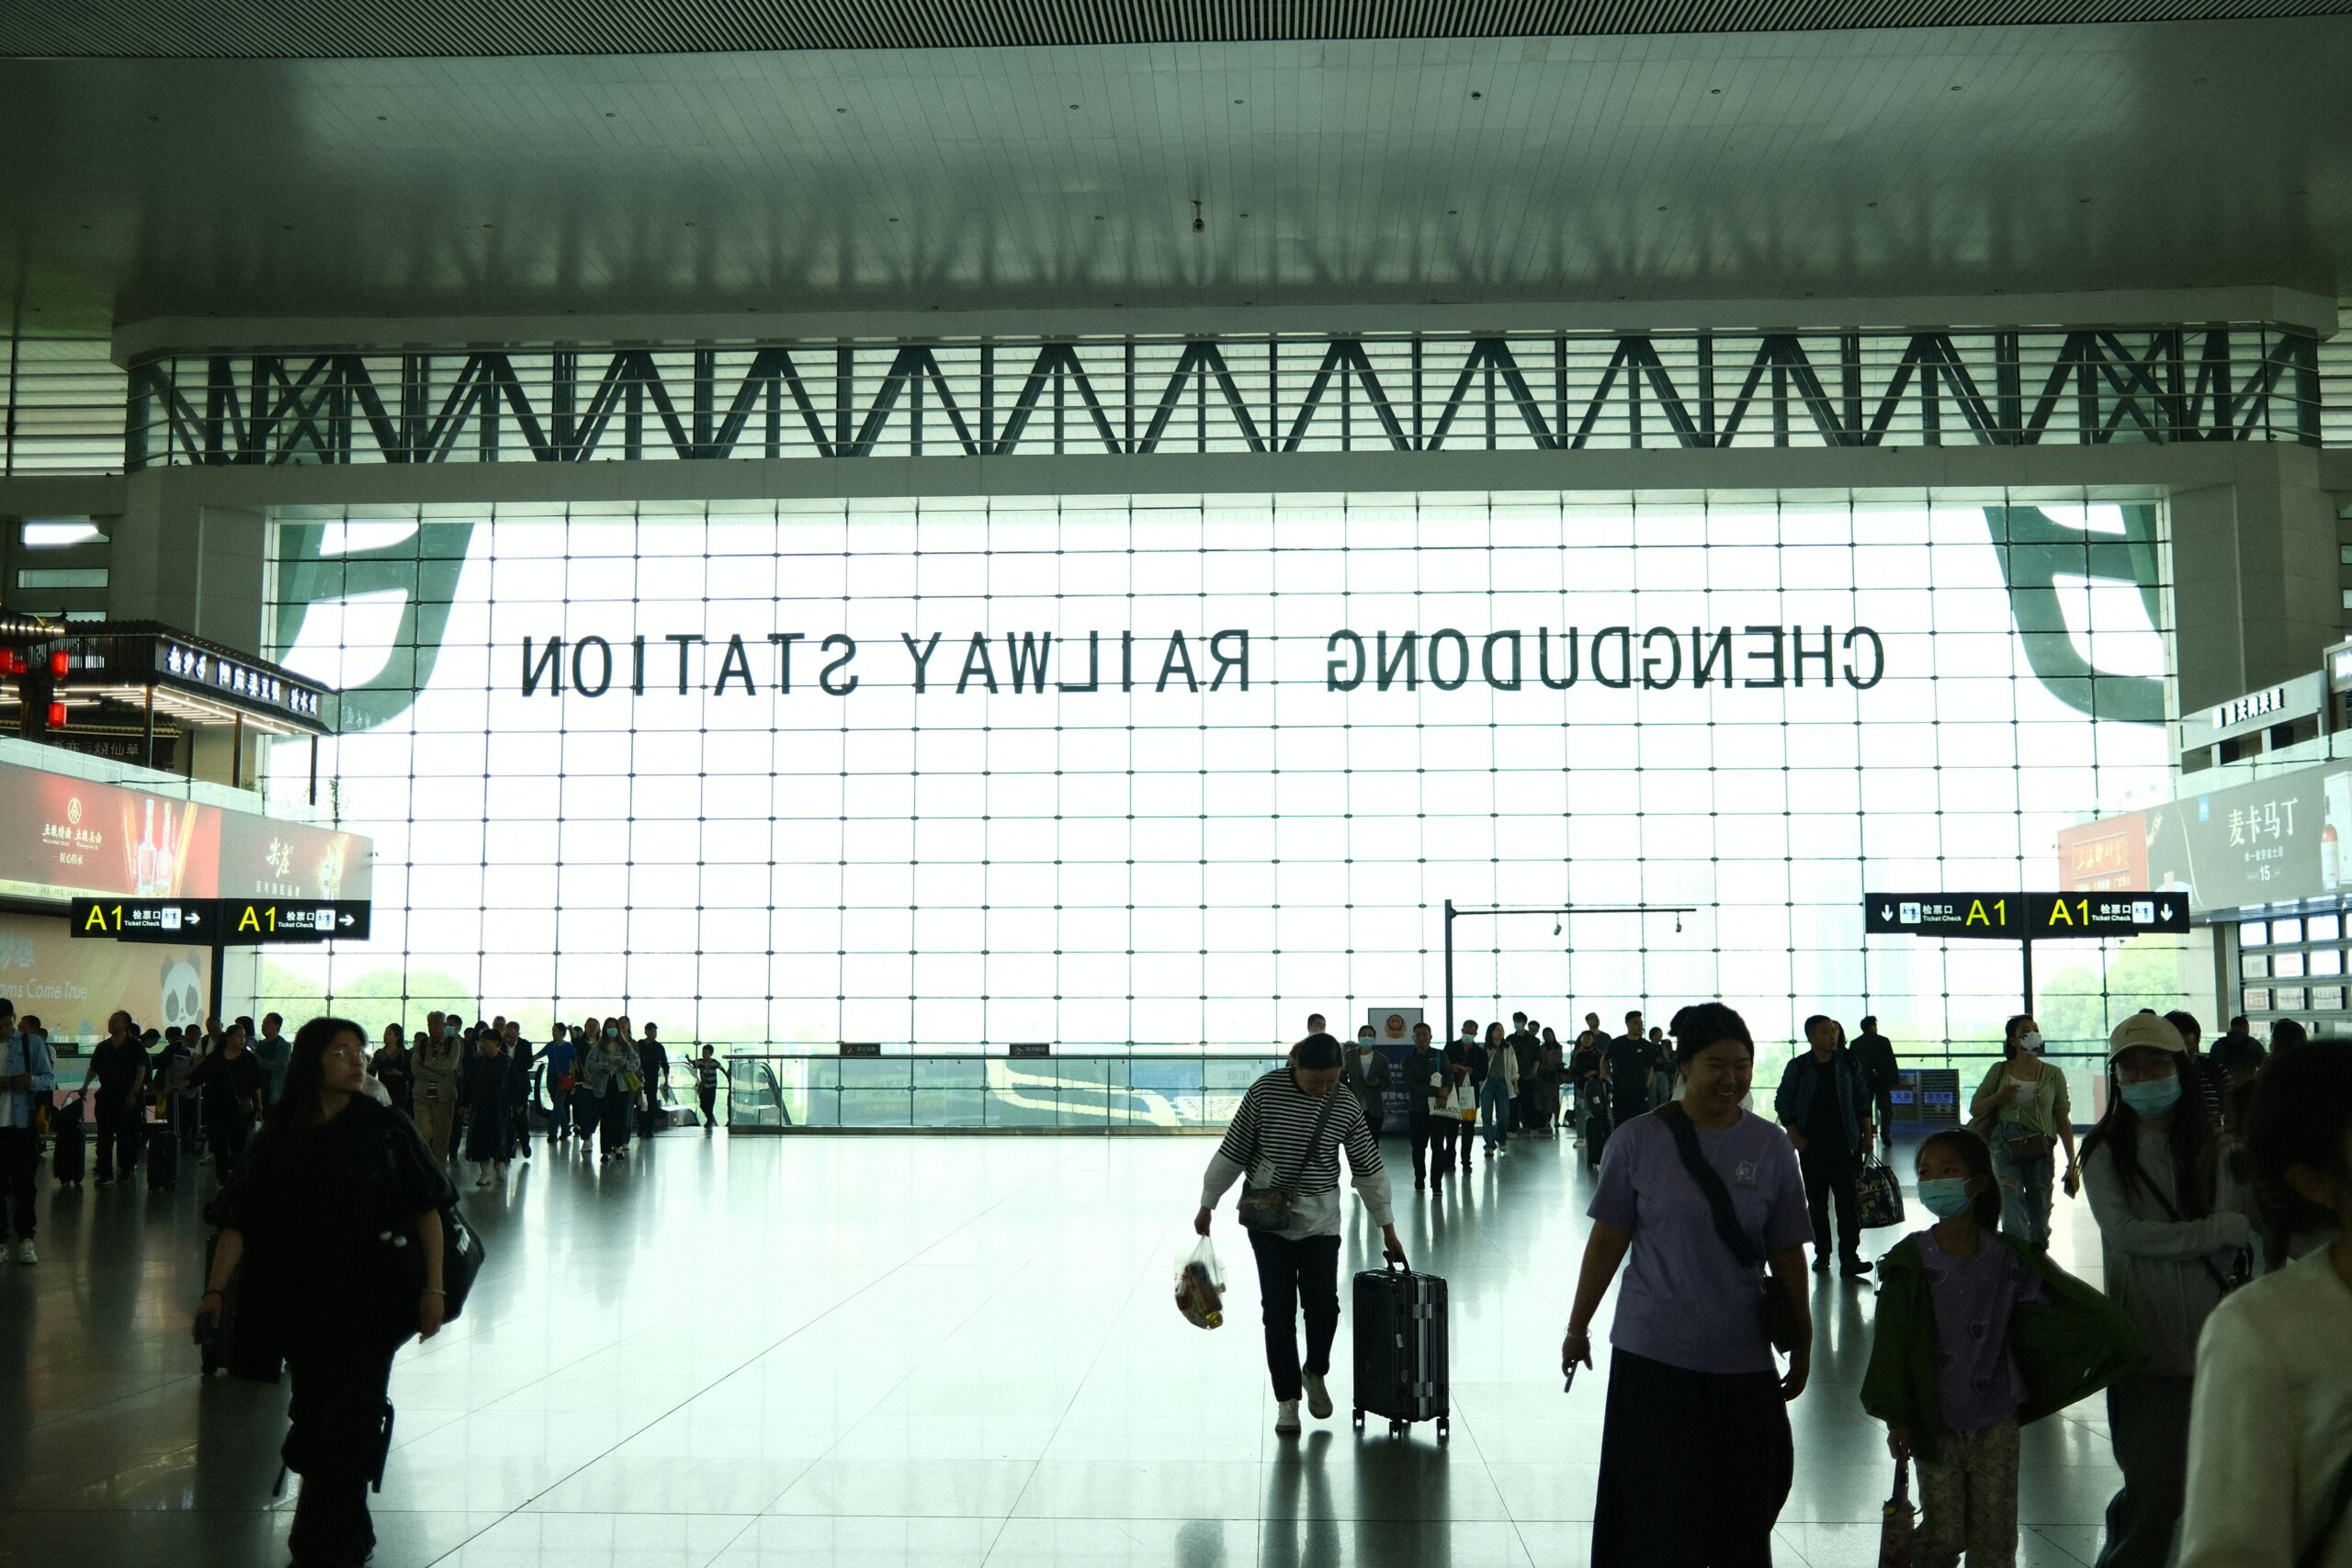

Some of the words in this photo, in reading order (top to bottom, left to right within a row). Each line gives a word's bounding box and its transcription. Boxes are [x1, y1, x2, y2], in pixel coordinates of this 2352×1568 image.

[2227, 796, 2299, 847] 麦卡马丁
[2259, 865, 2271, 882] 15
[85, 905, 123, 931] A1
[132, 909, 161, 920] 检票口
[238, 905, 276, 931] A1
[286, 910, 314, 921] 检票口
[1922, 904, 1953, 915] 检票口
[1965, 899, 2007, 926] A1
[2048, 898, 2089, 926] A1
[2100, 904, 2132, 915] 检票口
[27, 978, 62, 999] Come
[63, 980, 88, 1000] True
